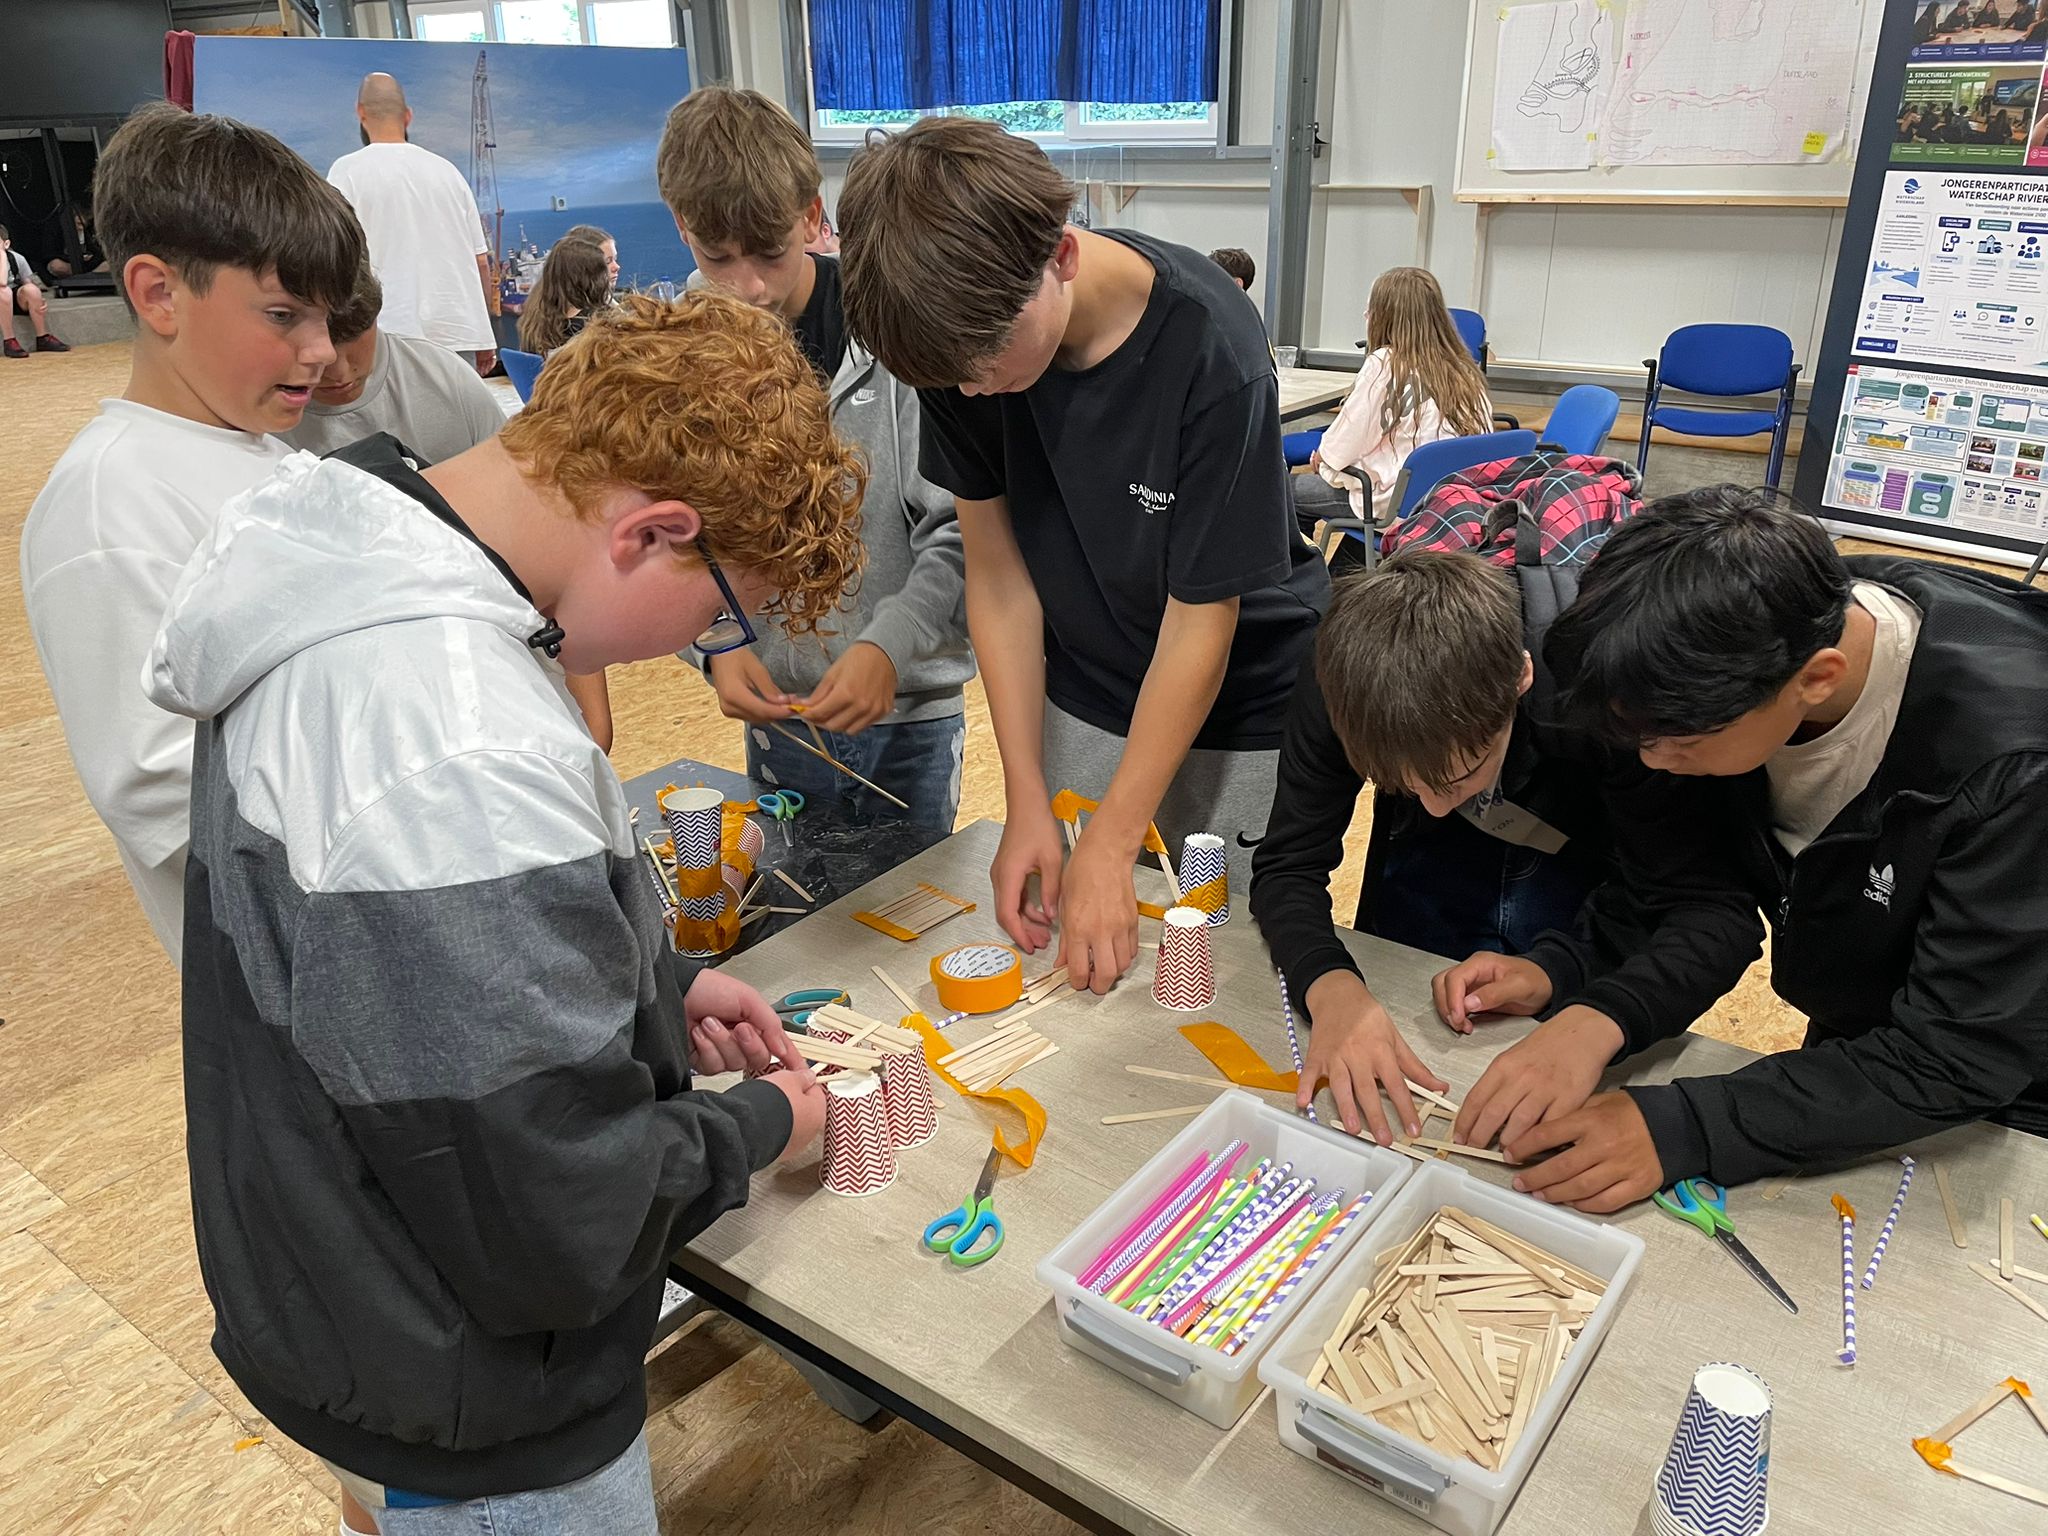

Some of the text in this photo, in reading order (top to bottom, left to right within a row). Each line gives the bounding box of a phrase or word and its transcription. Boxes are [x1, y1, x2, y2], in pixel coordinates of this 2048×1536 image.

[1949, 190, 2048, 204] WATERSCHAP RIVIER
[1989, 381, 2030, 393] waterschap
